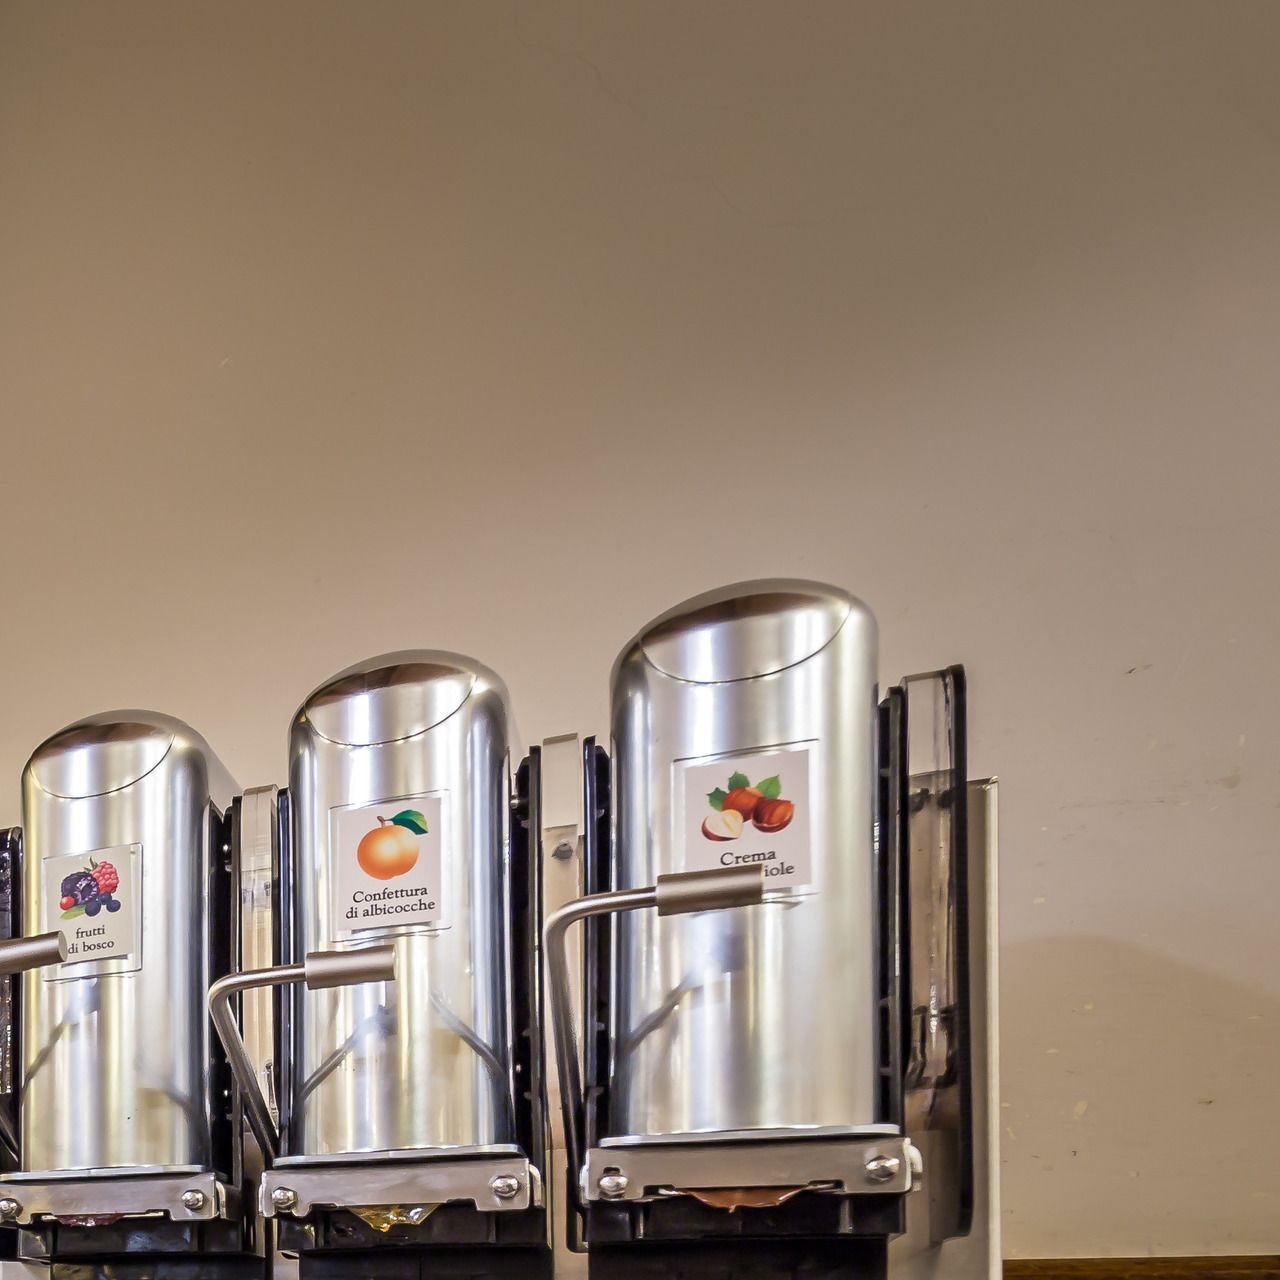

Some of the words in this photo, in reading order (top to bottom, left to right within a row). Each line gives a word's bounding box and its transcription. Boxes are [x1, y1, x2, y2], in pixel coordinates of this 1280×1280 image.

[720, 850, 776, 866] Crema
[764, 862, 796, 877] iole
[352, 886, 428, 903] Confettura
[346, 906, 358, 919] di
[362, 899, 436, 917] albicocche
[75, 925, 105, 939] frutti
[67, 942, 79, 954] di
[82, 939, 114, 952] bosco
